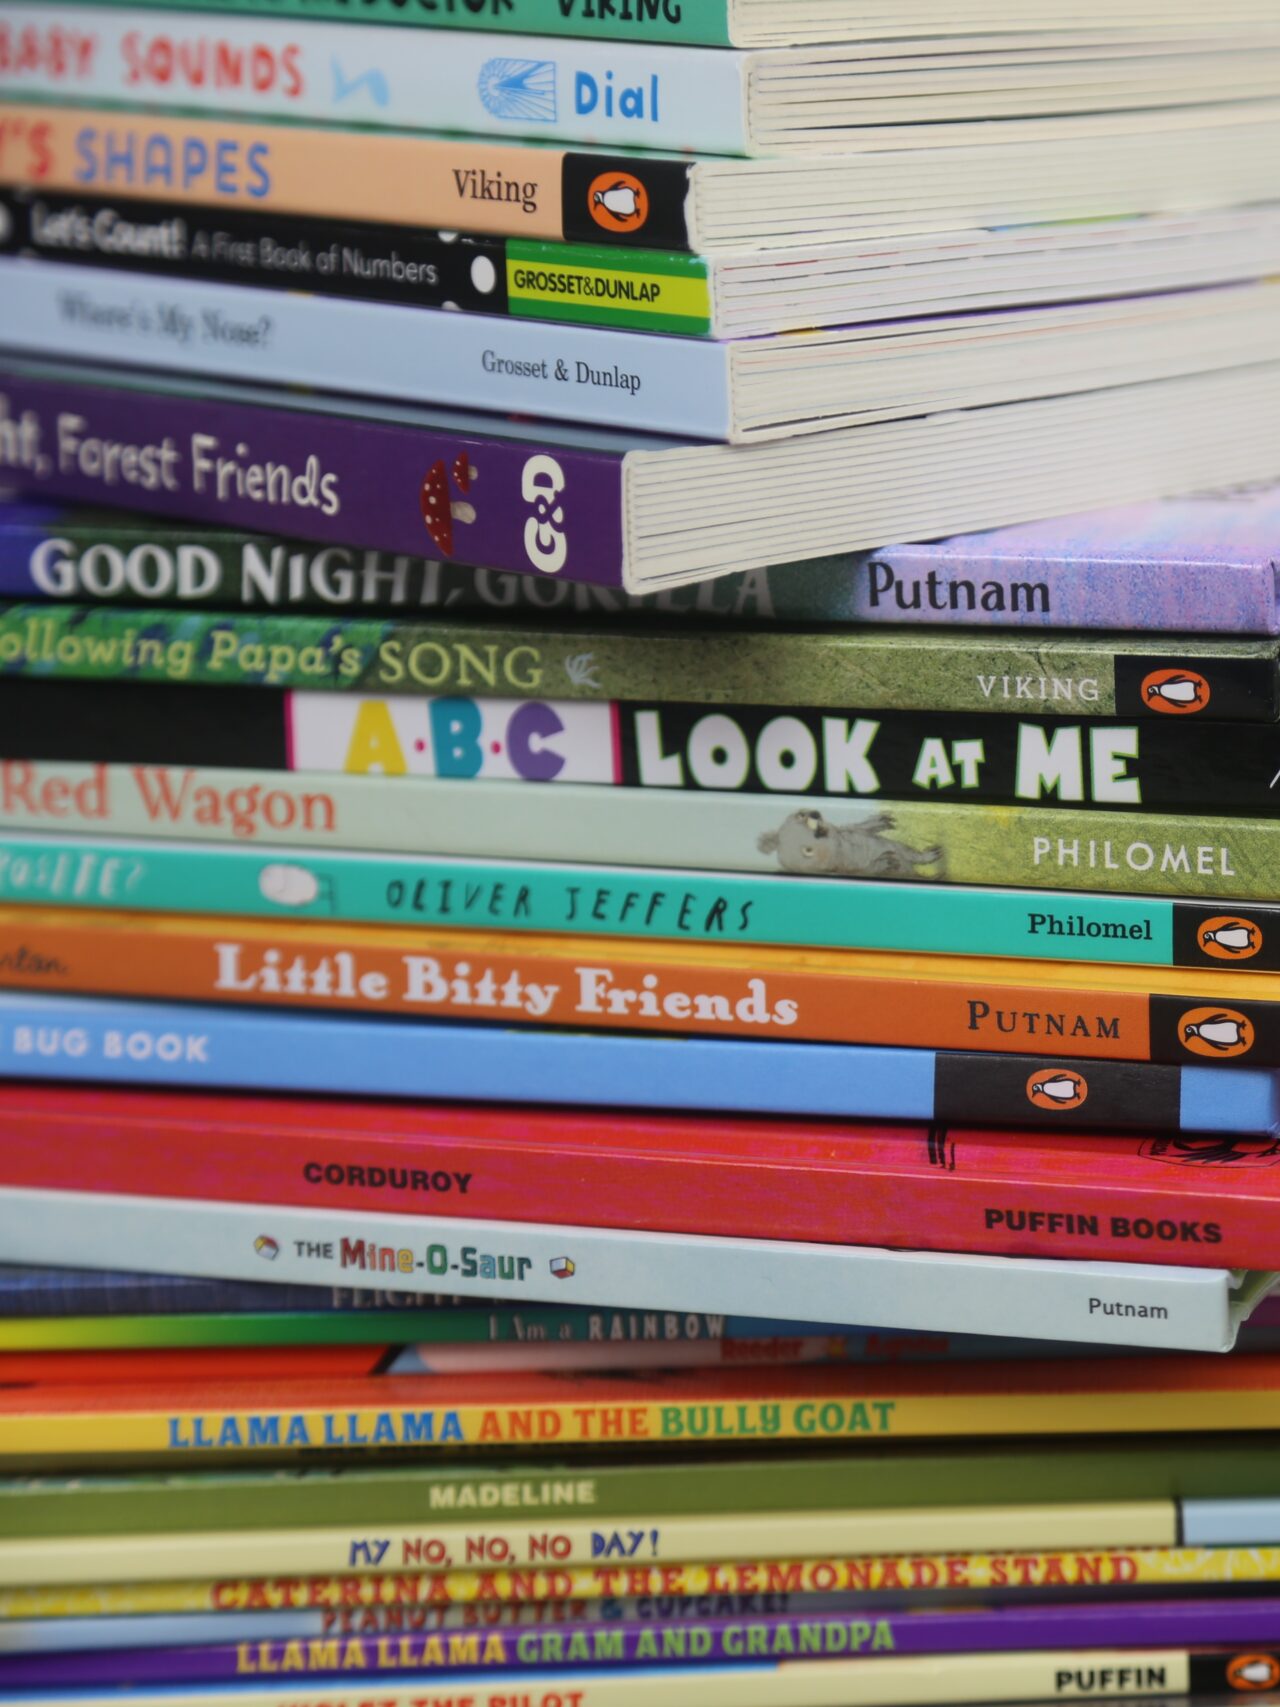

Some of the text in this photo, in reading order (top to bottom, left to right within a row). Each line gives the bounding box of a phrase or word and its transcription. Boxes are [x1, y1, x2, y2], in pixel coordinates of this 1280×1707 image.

[121, 31, 304, 98] SOUNDS
[575, 70, 658, 122] Dial
[0, 117, 271, 198] 'S SHAPES
[452, 168, 538, 213] Viking
[31, 203, 439, 284] Let's Count! A First Book of Numbers
[513, 268, 661, 303] GROSSET&DUNLAP
[482, 349, 641, 396] Grosset & Dunlap
[58, 412, 180, 491] Forest
[191, 432, 340, 516] Friends
[30, 538, 222, 598] GOOD
[868, 561, 1051, 613] Putnam
[206, 629, 363, 681] Papa's
[378, 640, 543, 689] SONG
[976, 674, 1099, 702] VIKING
[634, 709, 1142, 804] LOOK AT ME
[2, 760, 337, 839] Red Wagon
[1033, 837, 1236, 876] PHILOMEL
[386, 878, 754, 933] OLIVER JEFFERS
[1027, 913, 1153, 940] Philomel
[214, 942, 798, 1026] Little Bitty Friends
[966, 1000, 1121, 1039] PUTNAM
[13, 1026, 209, 1063] BUG BOOK
[303, 1162, 472, 1195] CORDUROY
[984, 1208, 1222, 1244] PUFFIN BOOKS
[294, 1240, 334, 1260] THE
[589, 1313, 727, 1341] RAINBOW
[1088, 1298, 1168, 1320] Putnam
[168, 1400, 896, 1449] LLAMA LLAMA AND THE BULLY GOAT
[429, 1479, 596, 1509] MADELINE
[349, 1529, 659, 1568] MY NO, NO, NO DAY!
[211, 1555, 1138, 1610] CATERINA AND THE LEMONADE STAND
[236, 1619, 896, 1674] LLAMA LLAMA GRAM AND GRANDPA
[1055, 1666, 1166, 1692] PUFFIN
